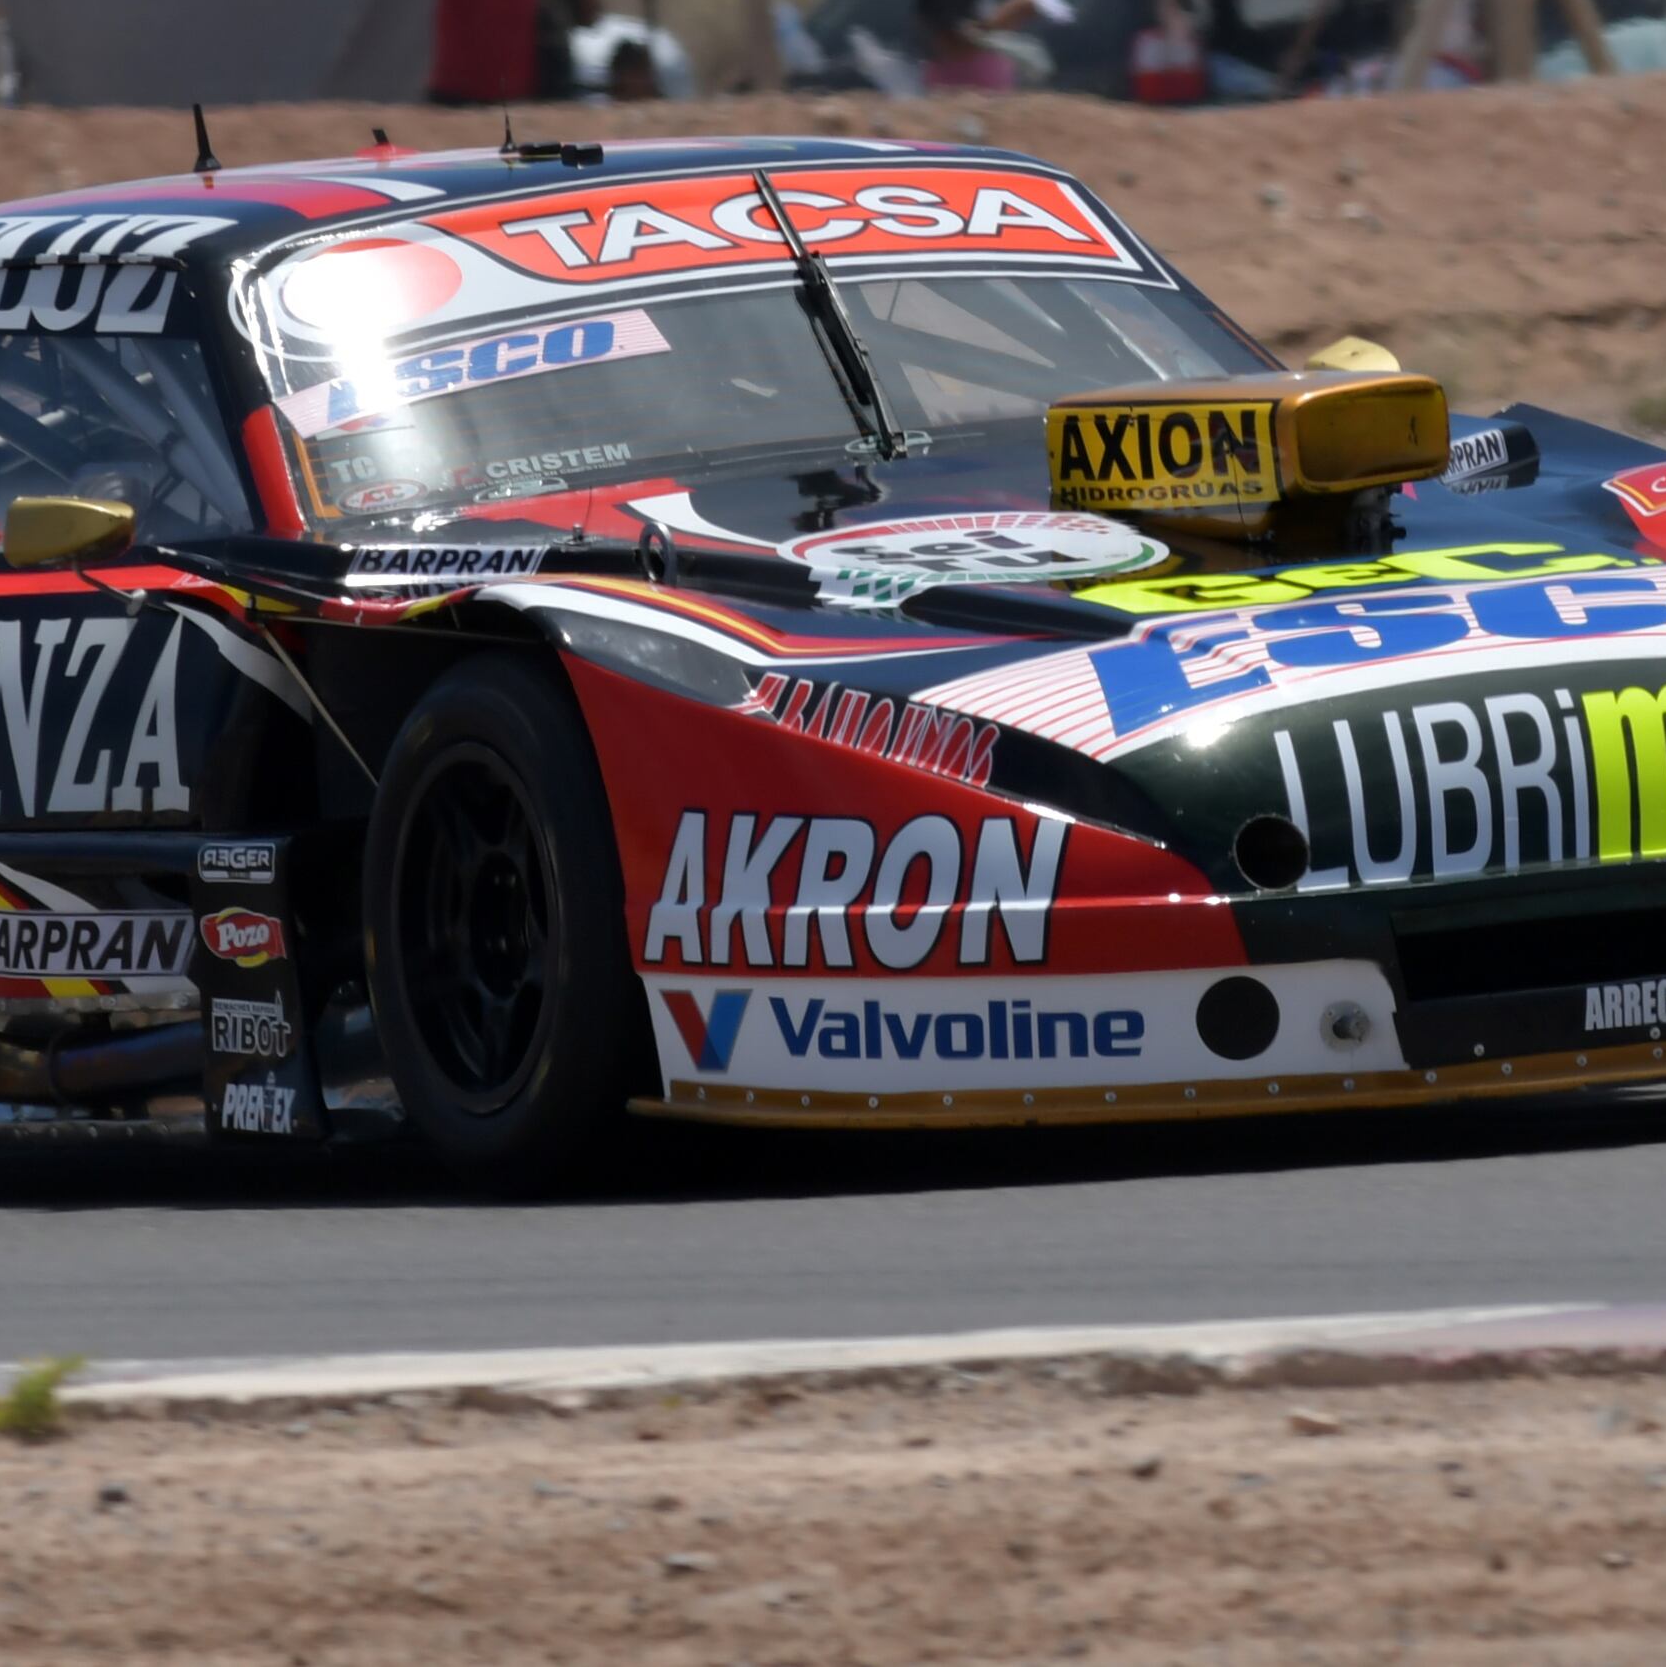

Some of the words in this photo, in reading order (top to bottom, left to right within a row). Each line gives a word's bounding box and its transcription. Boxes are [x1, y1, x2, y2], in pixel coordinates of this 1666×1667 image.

[502, 184, 1102, 268] TACSA
[486, 442, 632, 479] CRISTEM
[1060, 410, 1261, 481] AXION
[358, 548, 536, 575] BARPRAN
[644, 810, 1070, 969] AKRON
[769, 997, 1146, 1060] Valvoline
